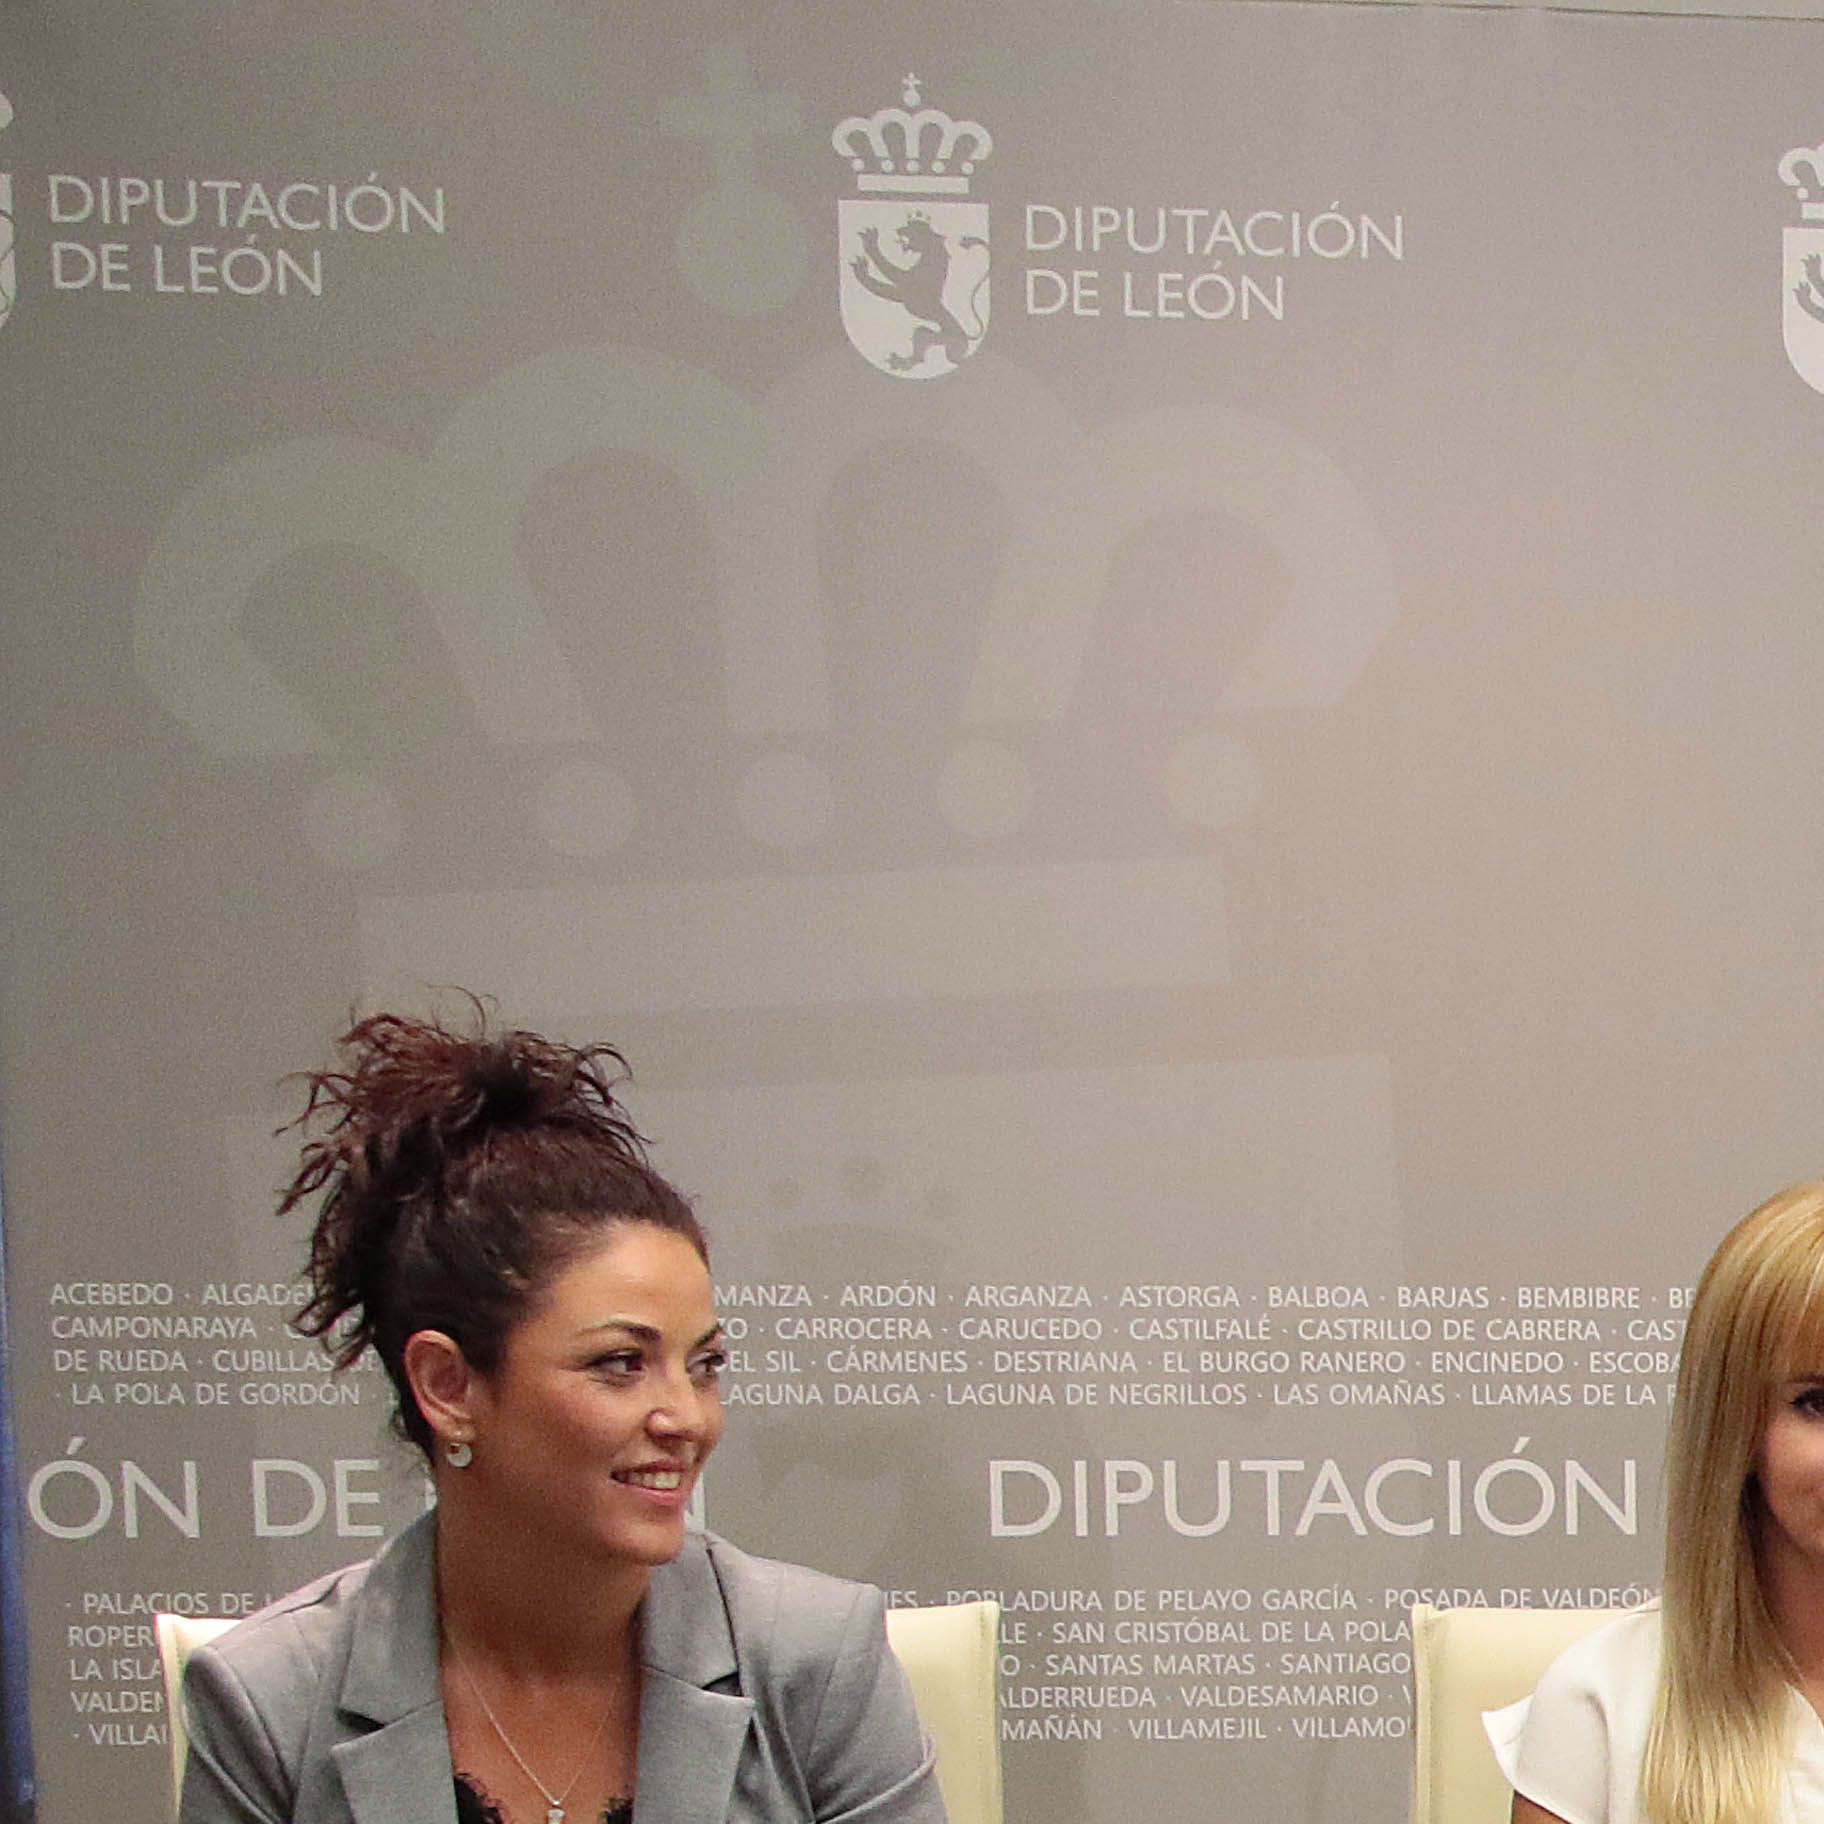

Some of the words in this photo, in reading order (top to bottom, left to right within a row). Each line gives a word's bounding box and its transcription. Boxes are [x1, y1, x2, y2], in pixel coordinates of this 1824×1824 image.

[49, 172, 444, 233] DIPUTACIÓN
[1026, 201, 1402, 259] DIPUTACIÓN
[52, 242, 130, 291] DE
[154, 234, 321, 295] LEÓN
[1027, 270, 1099, 316] DE
[1124, 261, 1283, 319] LEÓN
[49, 1282, 174, 1306] ACEBEDO
[840, 1279, 936, 1307] ARDÓN
[964, 1284, 1093, 1308] ARGANZA
[1119, 1285, 1240, 1308] ASTORGA
[1268, 1285, 1370, 1309] BALBOA
[1397, 1285, 1490, 1309] BARJAS
[1517, 1286, 1640, 1309] BEMBIBRE
[51, 1315, 258, 1339] CAMPONARAYA
[775, 1317, 933, 1340] CARROCERA
[958, 1317, 1103, 1341] CARUCEDO
[1129, 1312, 1271, 1341] CASTILFALÉ
[826, 1344, 968, 1373] CÁRMENES
[993, 1350, 1138, 1373] DESTRIANA
[1431, 1350, 1564, 1374] ENCINEDO
[71, 1382, 105, 1405] LA
[114, 1382, 186, 1406] POLA
[195, 1382, 230, 1406] DE
[239, 1377, 360, 1406] GORDÓN
[946, 1382, 1056, 1406] LAGUNA
[1065, 1383, 1098, 1406] DE
[1109, 1382, 1247, 1406] NEGRILLOS
[252, 1459, 383, 1537] DE
[990, 1437, 1636, 1536] DIPUTACIÓN
[1052, 1621, 1105, 1644] SAN
[1114, 1616, 1251, 1644] CRISTÓBAL
[1179, 1684, 1379, 1708] VALDESAMARIO
[1127, 1717, 1268, 1740] VILLAMEJIL
